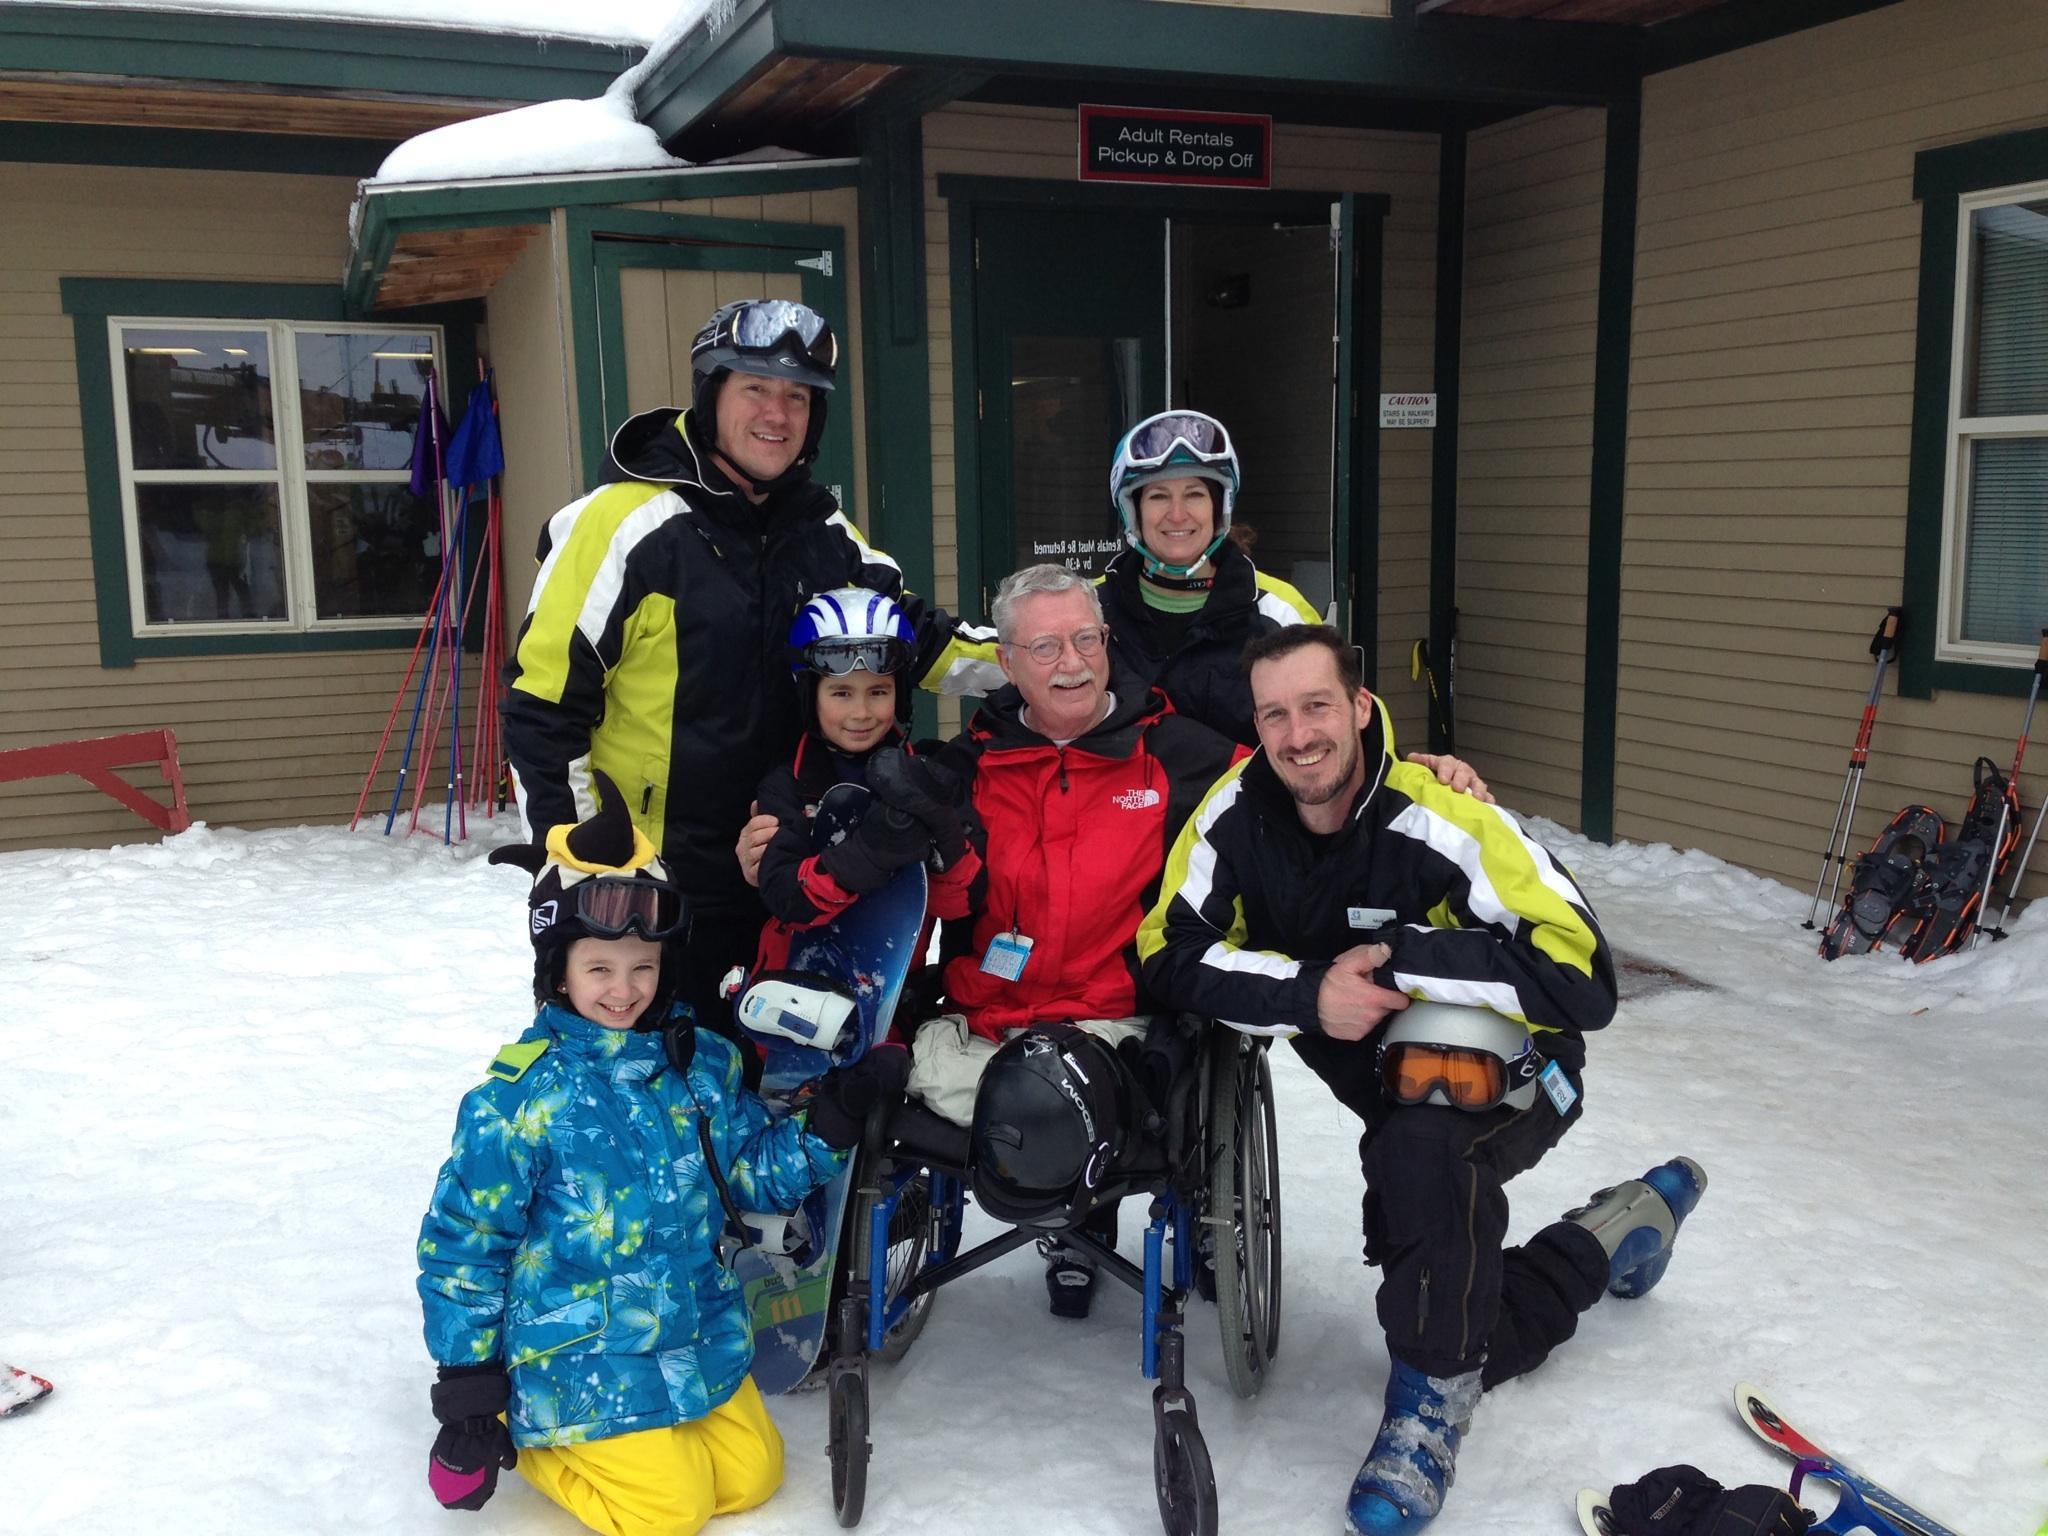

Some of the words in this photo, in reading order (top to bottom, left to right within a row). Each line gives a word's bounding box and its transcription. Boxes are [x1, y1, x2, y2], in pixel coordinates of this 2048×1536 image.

[1118, 126, 1164, 143] Adult
[1169, 129, 1234, 147] Rentals
[1098, 147, 1159, 167] Pickup
[1164, 150, 1177, 165] &
[1182, 151, 1224, 170] Drop
[1229, 152, 1253, 168] Off
[1388, 396, 1431, 406] CAUTION
[1126, 789, 1145, 797] THE
[1112, 795, 1145, 804] NORTH
[1121, 802, 1145, 810] FACE
